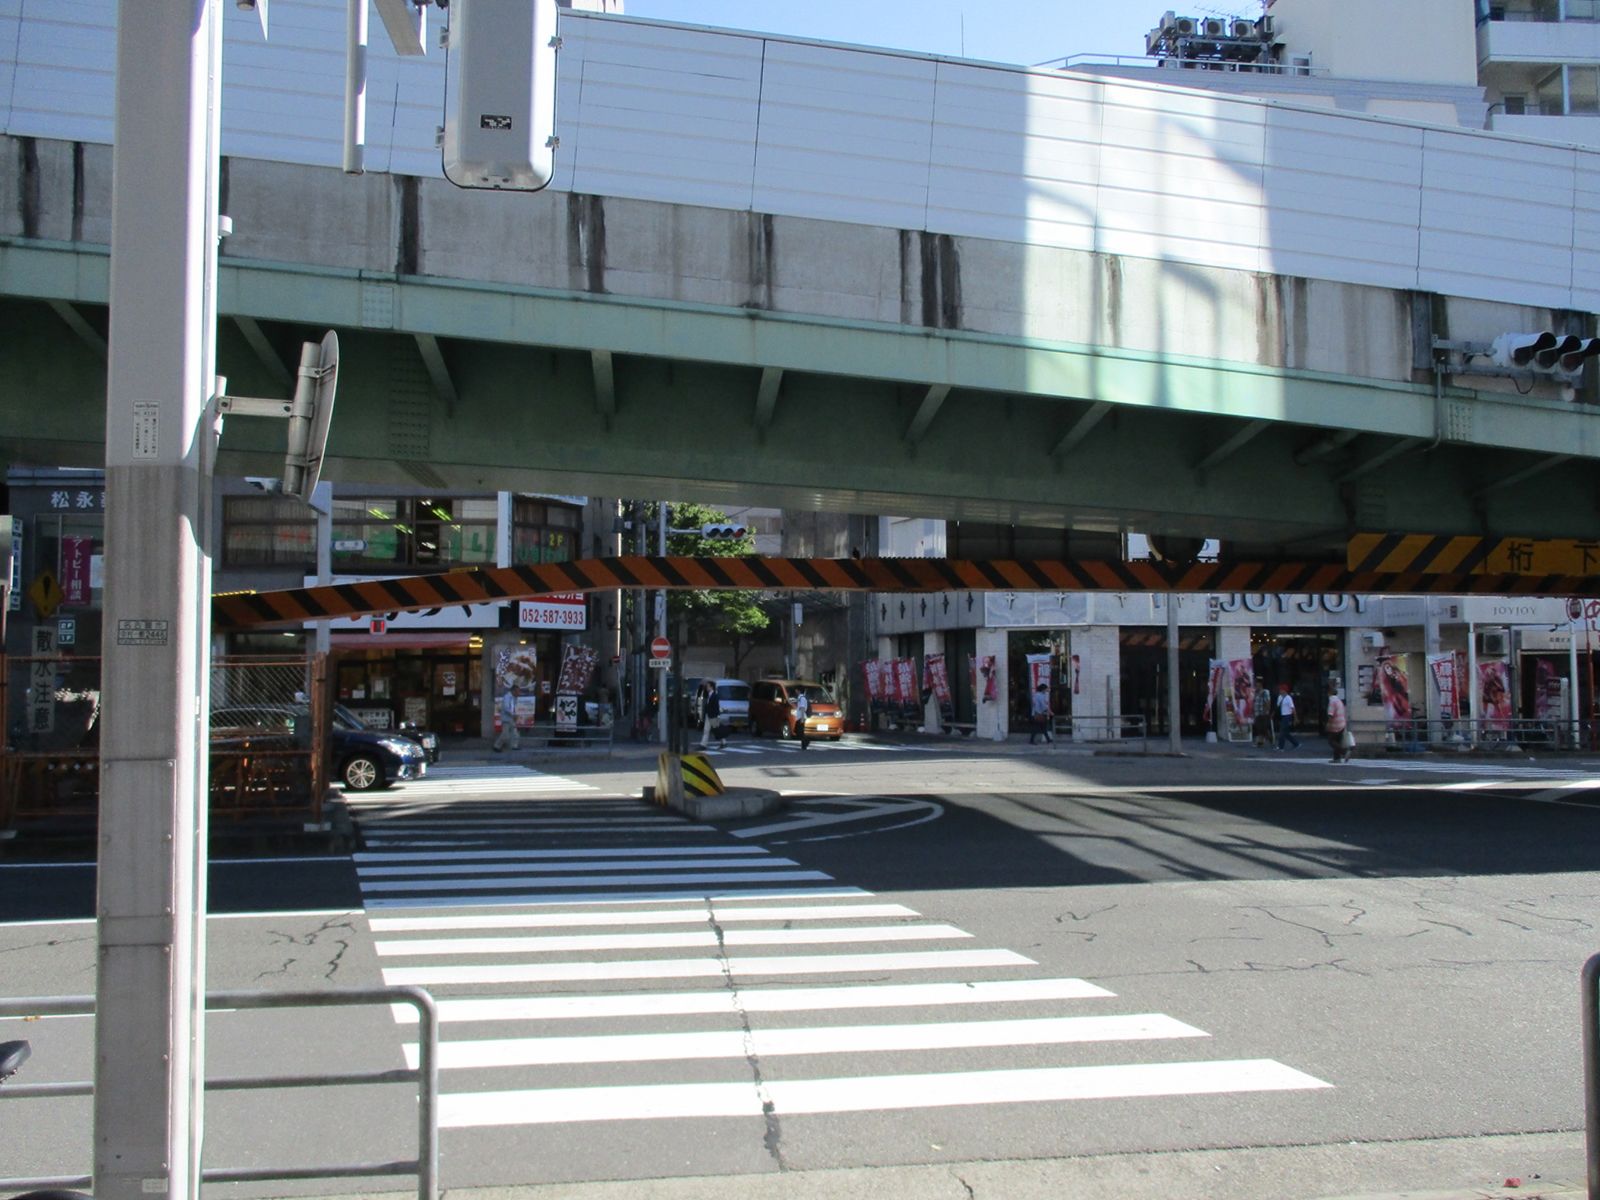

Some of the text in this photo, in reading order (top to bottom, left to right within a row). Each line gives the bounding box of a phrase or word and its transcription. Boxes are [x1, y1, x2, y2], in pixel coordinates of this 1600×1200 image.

[1220, 593, 1369, 613] JOYJOY
[1493, 605, 1537, 616] JOYJOY
[34, 630, 53, 730] 散水注意
